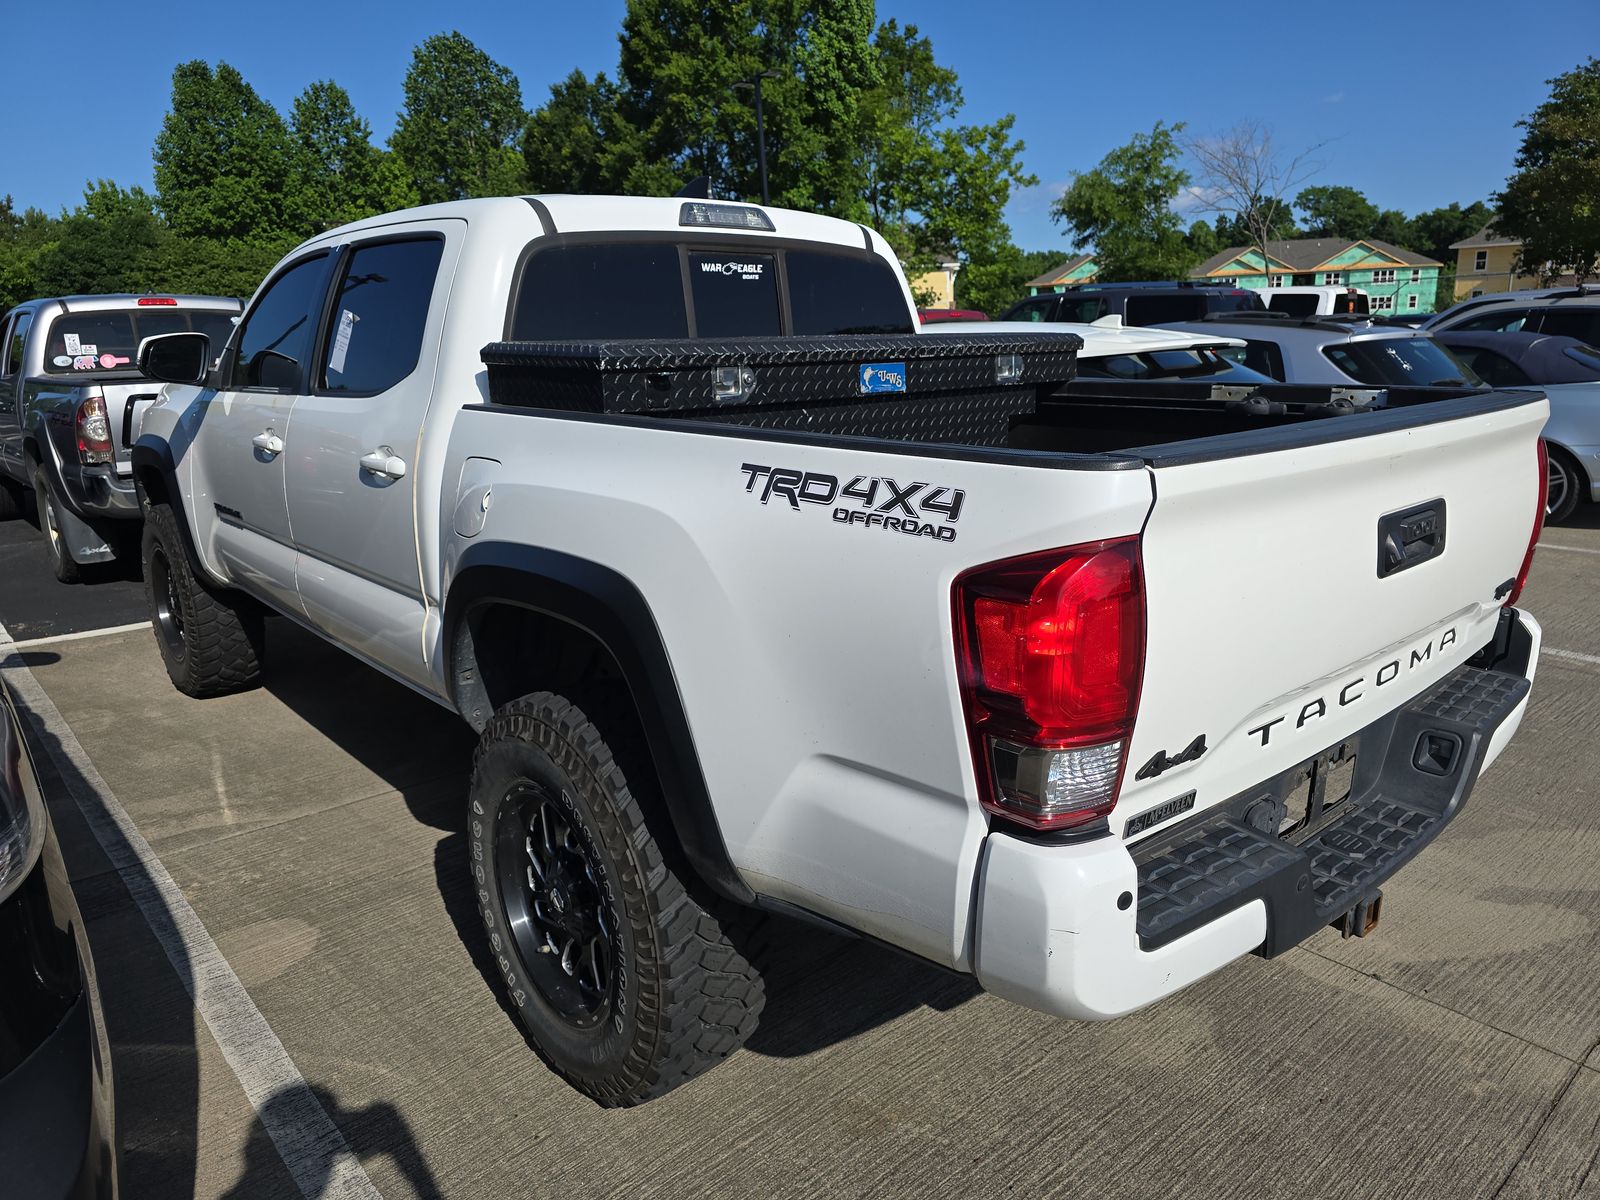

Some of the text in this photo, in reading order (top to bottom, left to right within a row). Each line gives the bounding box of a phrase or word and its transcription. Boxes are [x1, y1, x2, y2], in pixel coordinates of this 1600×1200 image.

[701, 262, 763, 273] WAR EAGLE
[877, 370, 902, 387] UWS
[741, 463, 966, 523] TRD 4X4
[832, 507, 957, 543] OFFROAD
[1247, 626, 1458, 747] TACOMA
